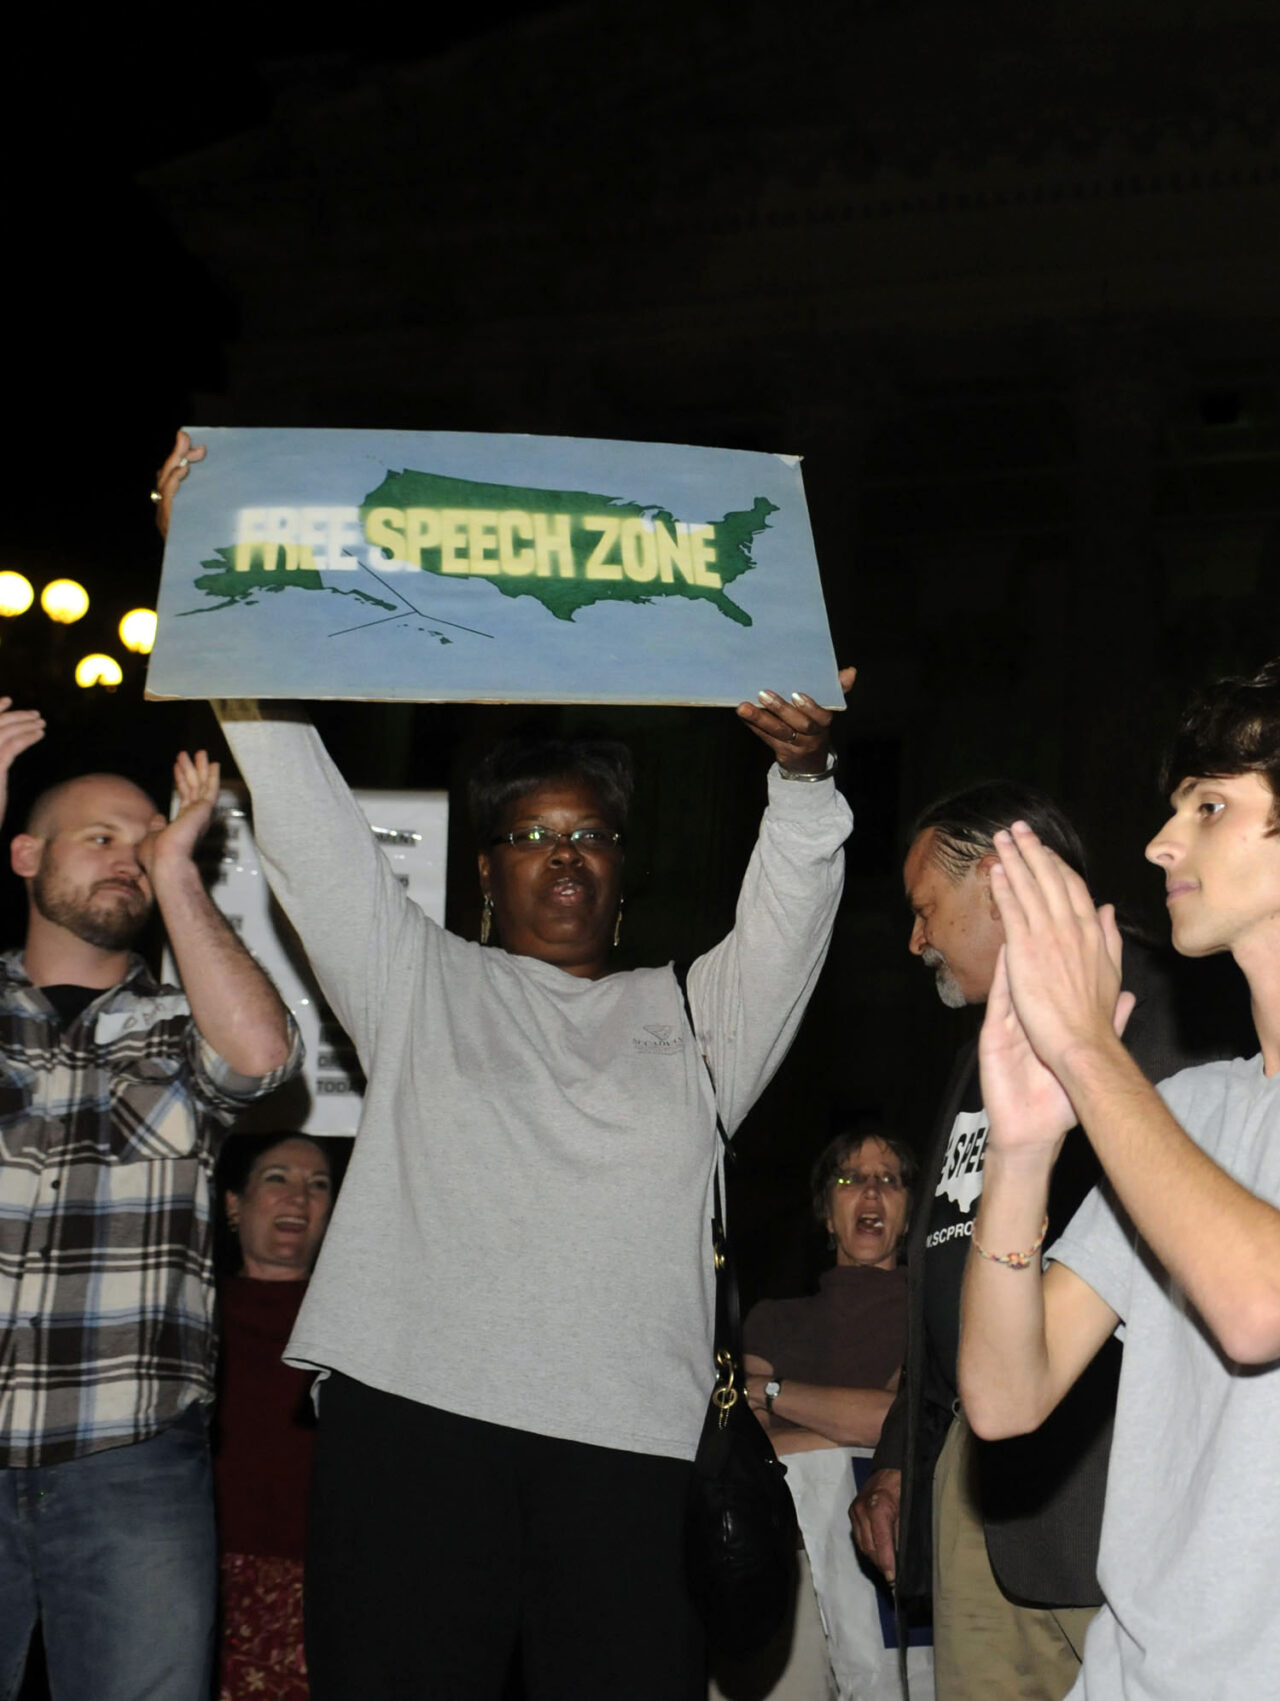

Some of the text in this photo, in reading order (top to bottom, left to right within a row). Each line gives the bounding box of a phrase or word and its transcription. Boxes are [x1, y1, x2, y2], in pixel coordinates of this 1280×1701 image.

[234, 505, 723, 590] FREE SPEECH ZONE
